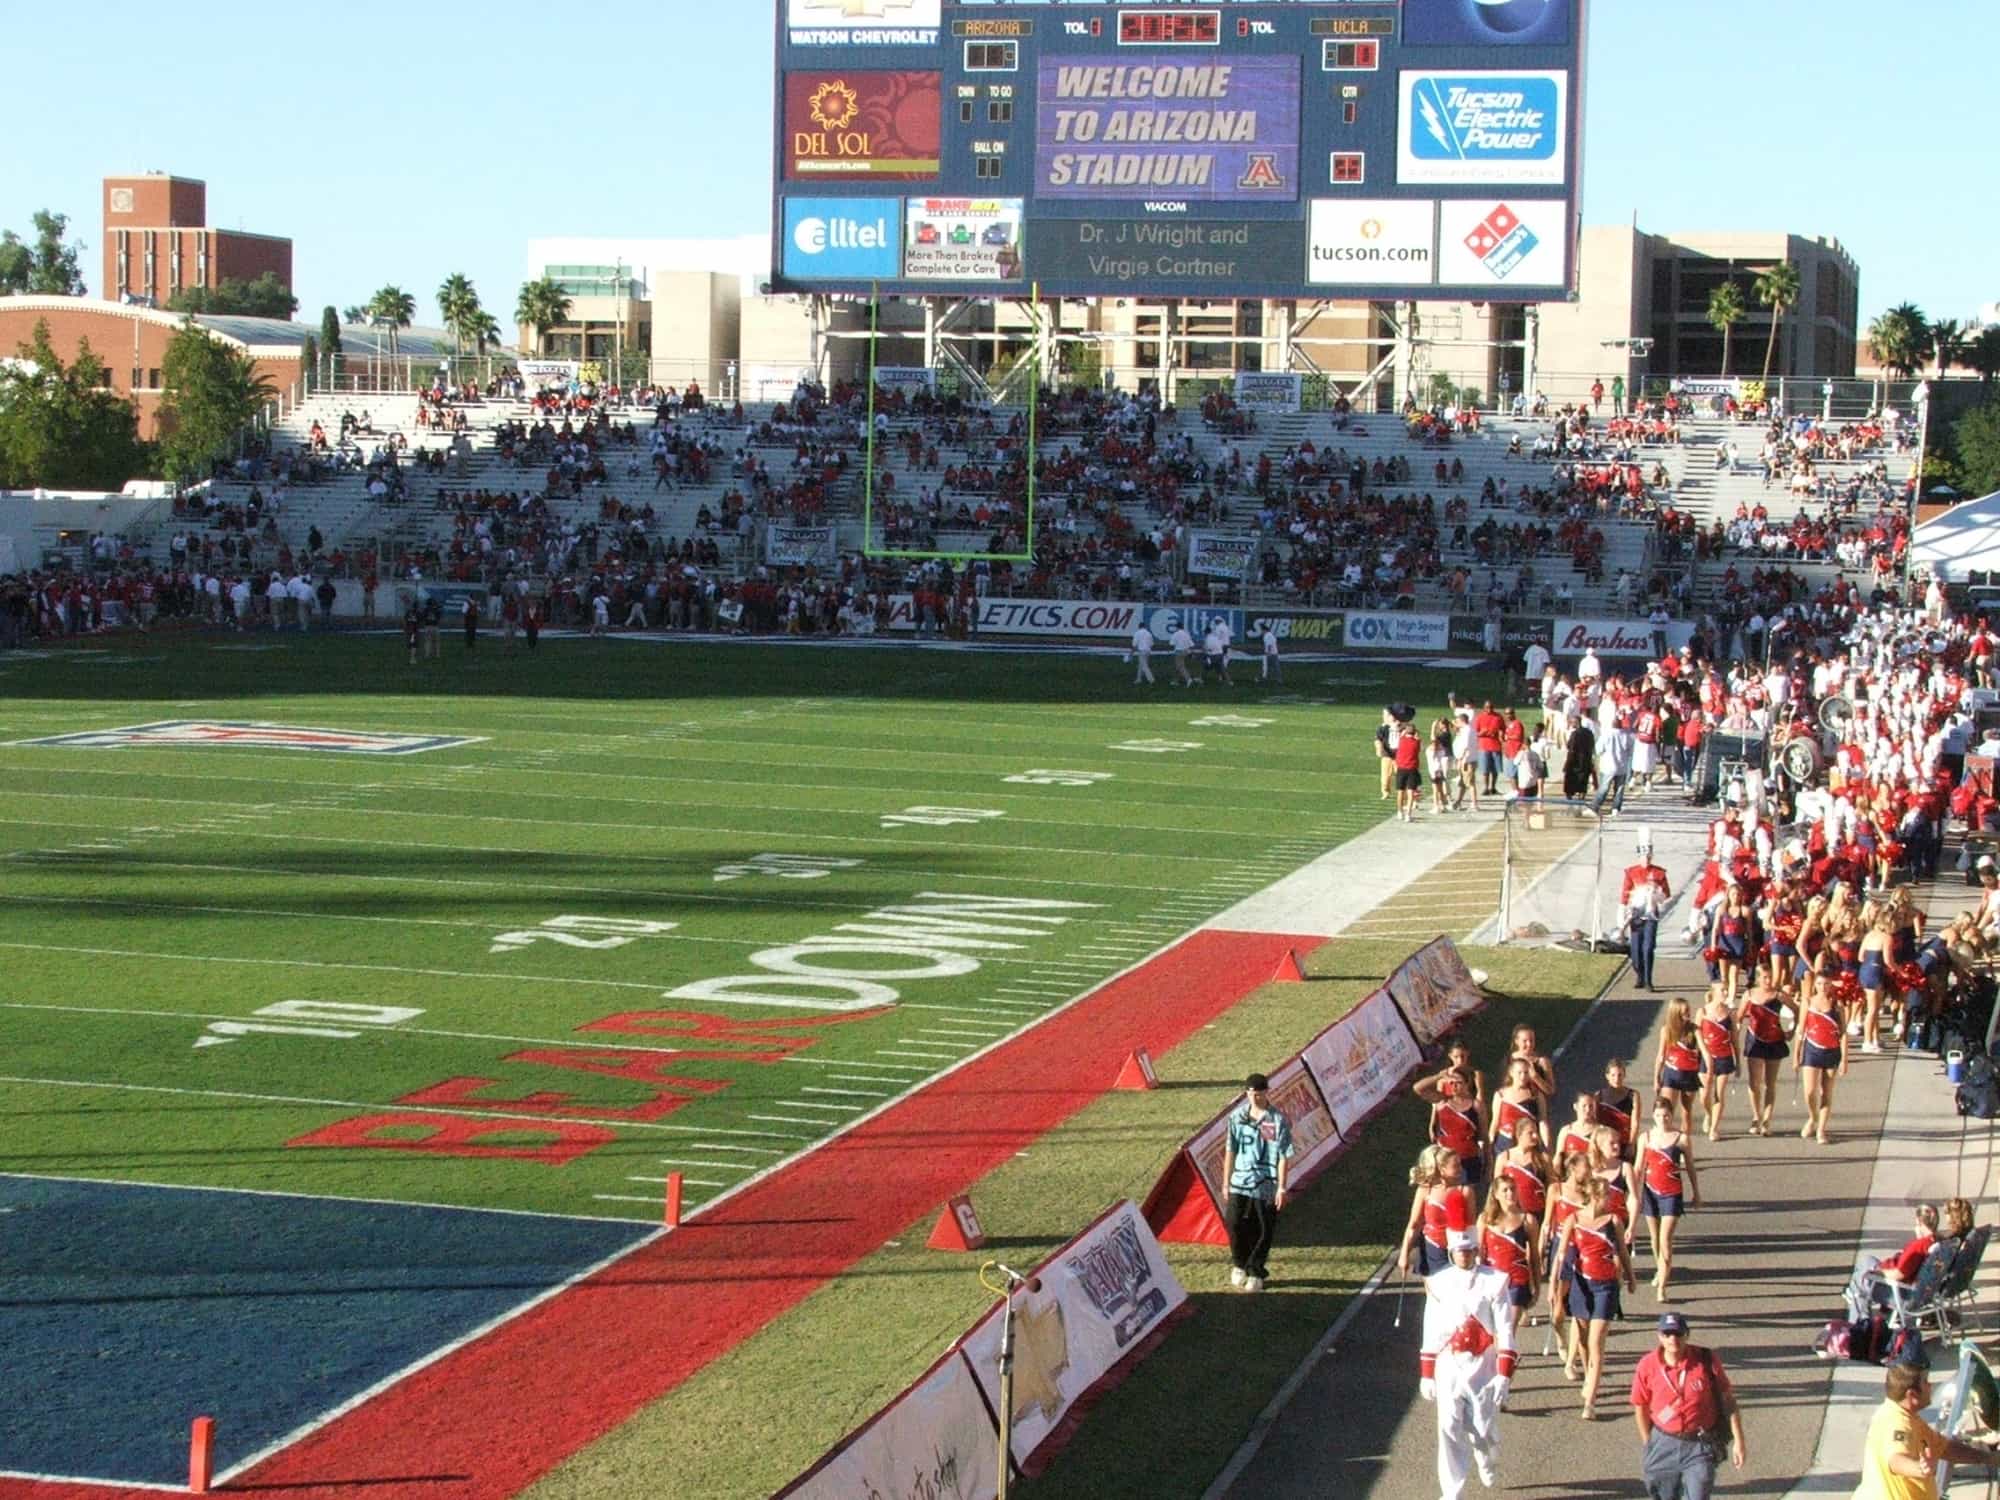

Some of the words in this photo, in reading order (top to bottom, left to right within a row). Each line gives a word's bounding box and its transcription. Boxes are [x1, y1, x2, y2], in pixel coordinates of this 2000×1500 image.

[790, 31, 849, 44] WATSON
[852, 31, 938, 44] CHEVROLET
[965, 21, 1019, 35] ARIZONA
[1064, 22, 1088, 35] TOL
[1251, 22, 1276, 34] TOL
[1333, 20, 1368, 33] UCLA
[989, 86, 999, 97] TO
[1001, 86, 1012, 97] GO
[1056, 66, 1232, 98] WELCOME
[1447, 87, 1524, 109] Tucson
[1054, 111, 1098, 142] TO
[1102, 111, 1257, 142] ARIZONA
[1454, 110, 1544, 128] Electric
[795, 132, 829, 155] DEL
[837, 132, 872, 155] SOL
[974, 142, 991, 153] BALL
[993, 142, 1004, 153] ON
[1462, 129, 1543, 149] Power
[1050, 154, 1214, 185] STADIUM
[1145, 202, 1187, 212] VIACOM
[799, 217, 887, 251] alltel
[1080, 224, 1109, 243] Dr.
[1116, 224, 1128, 243] J
[1134, 224, 1204, 248] Wright
[1209, 224, 1249, 244] and
[907, 250, 933, 260] More
[936, 250, 958, 260] Than
[961, 250, 994, 260] Brakes
[1313, 245, 1429, 262] tucson.com
[907, 263, 952, 274] Complete
[954, 263, 970, 273] Car
[973, 263, 996, 273] Care
[1088, 256, 1150, 280] Virgie
[1156, 256, 1235, 276] Cortner
[978, 604, 1135, 630] ETICS.COM
[1157, 607, 1234, 638] alltl
[1246, 617, 1343, 640] SUBWAY
[1350, 617, 1392, 641] COX
[1562, 625, 1654, 651] Bashas'
[492, 915, 680, 949] 20
[206, 1000, 428, 1038] 10
[285, 1008, 896, 1166] BEAR
[662, 891, 1111, 1011] DOWN
